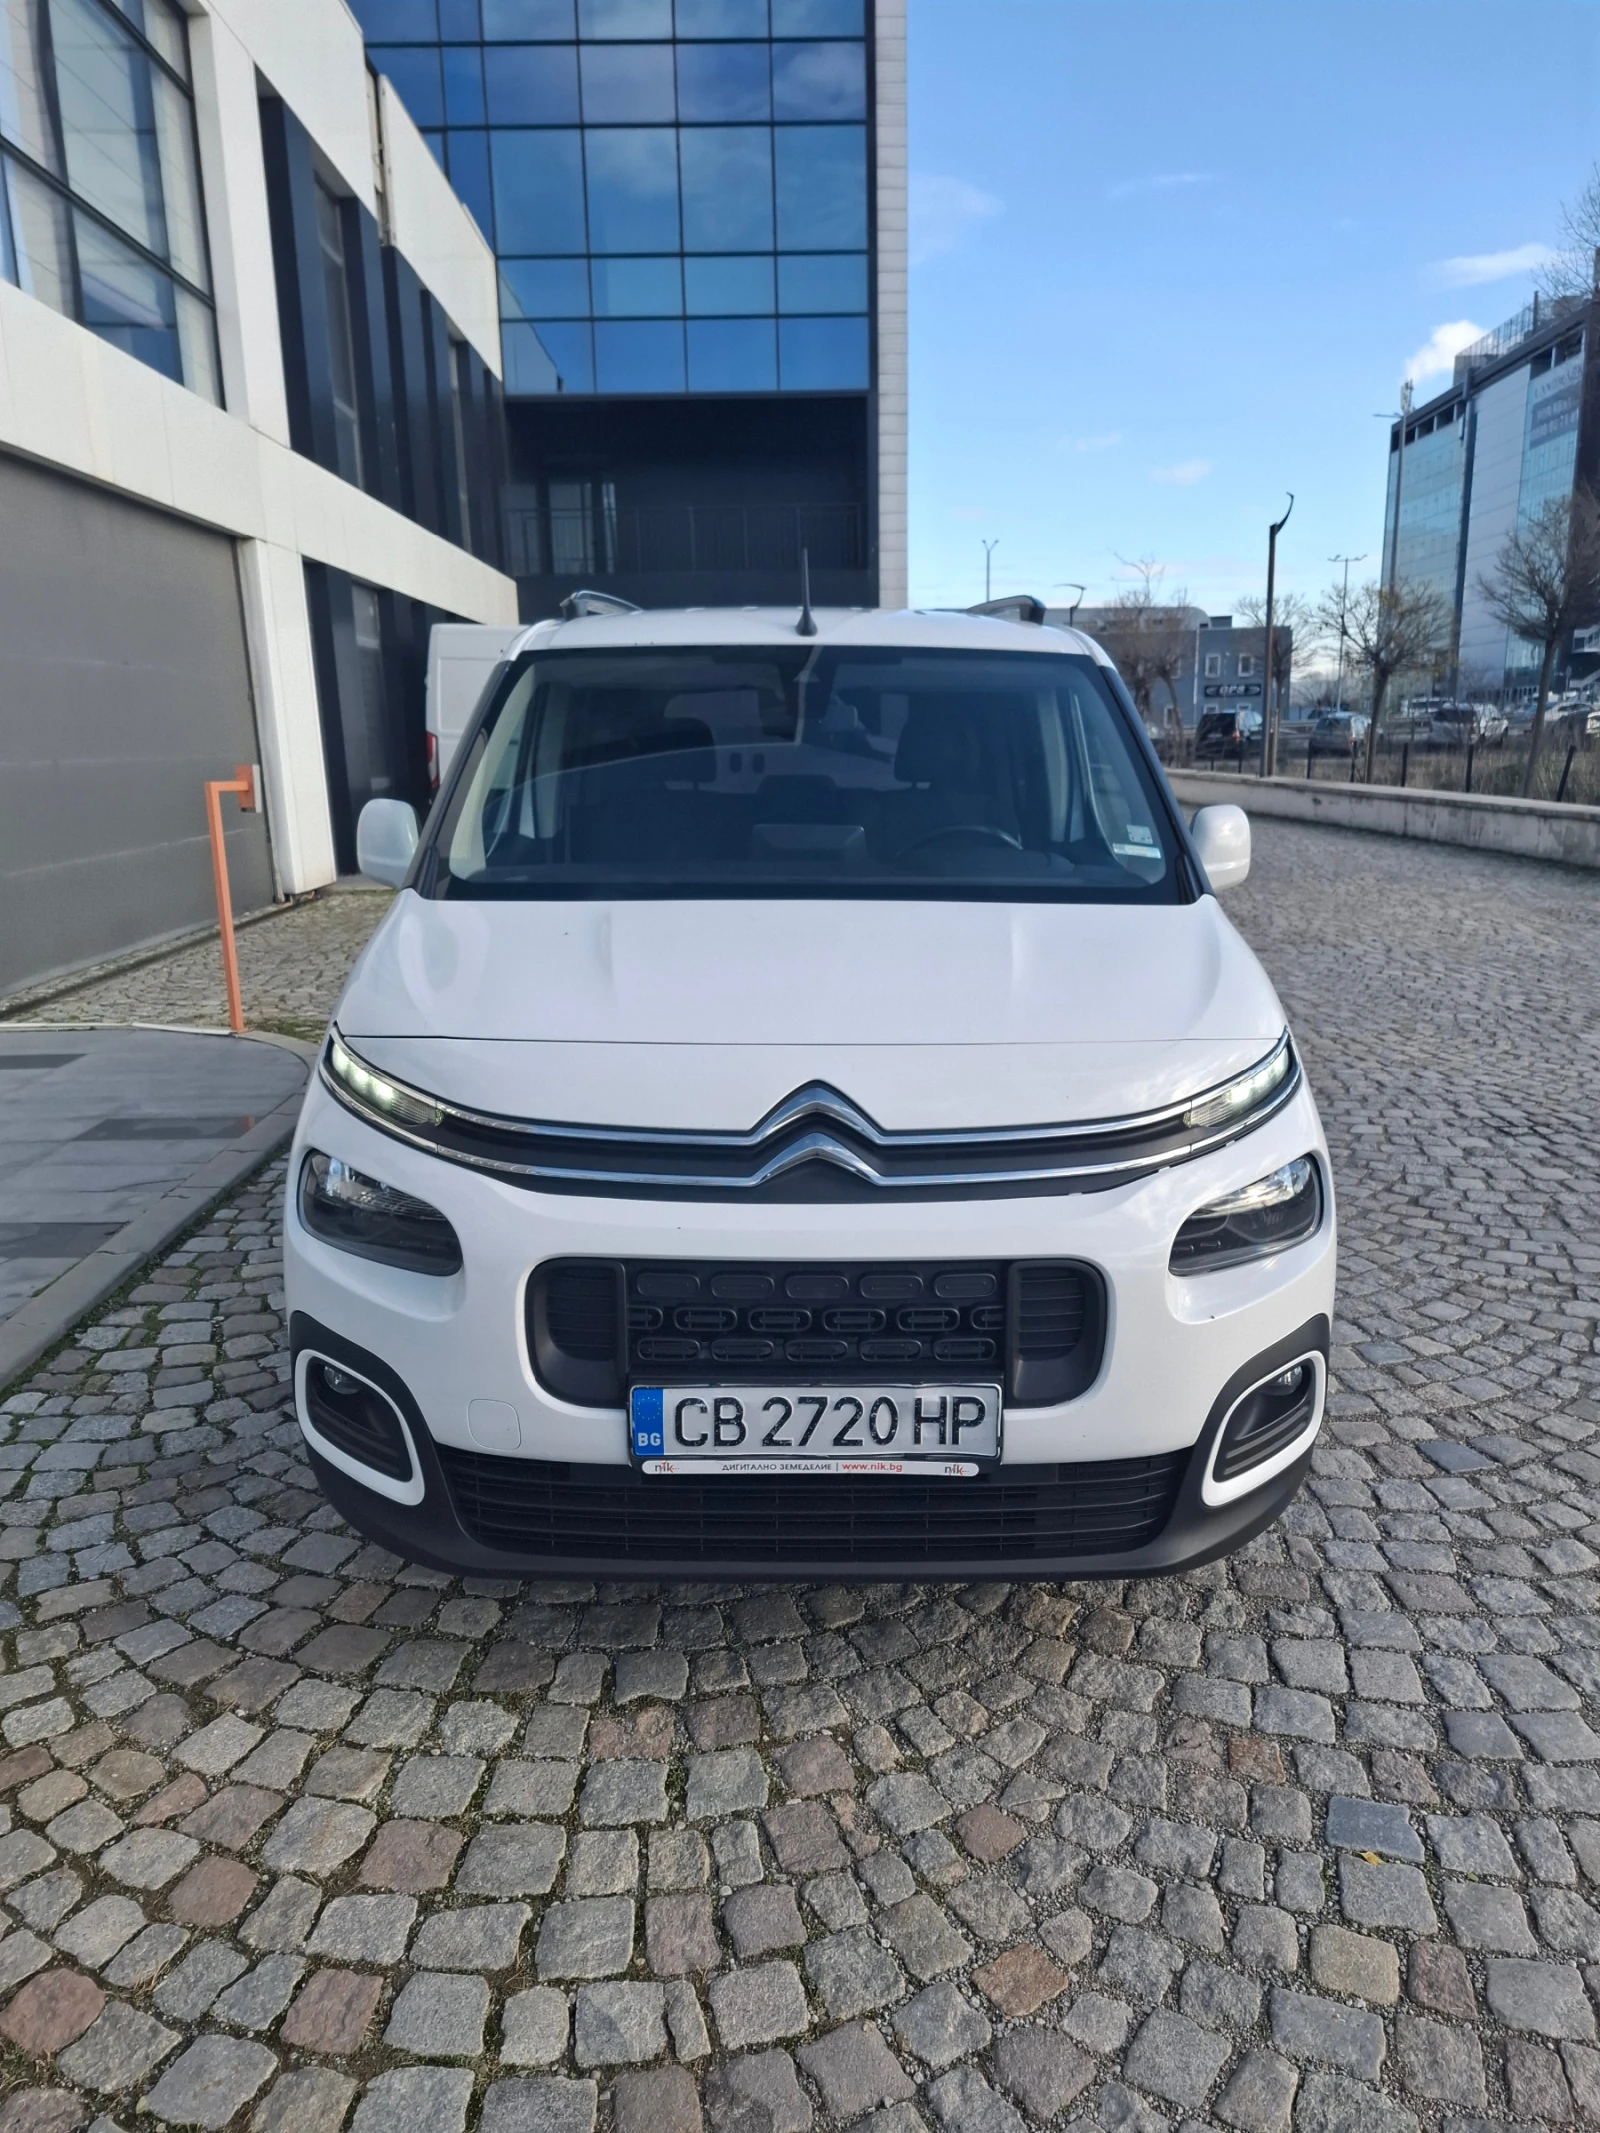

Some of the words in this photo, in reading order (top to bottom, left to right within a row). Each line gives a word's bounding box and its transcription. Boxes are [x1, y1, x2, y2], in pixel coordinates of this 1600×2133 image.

[675, 1397, 747, 1447] CB
[762, 1396, 898, 1447] 2720
[914, 1396, 986, 1445] HP
[637, 1432, 661, 1447] BG
[722, 1463, 777, 1471] ДИГИТАЛНО
[779, 1463, 832, 1471] ЗЕМЕДЕЛИЕ
[842, 1462, 903, 1473] www.nik.bg
